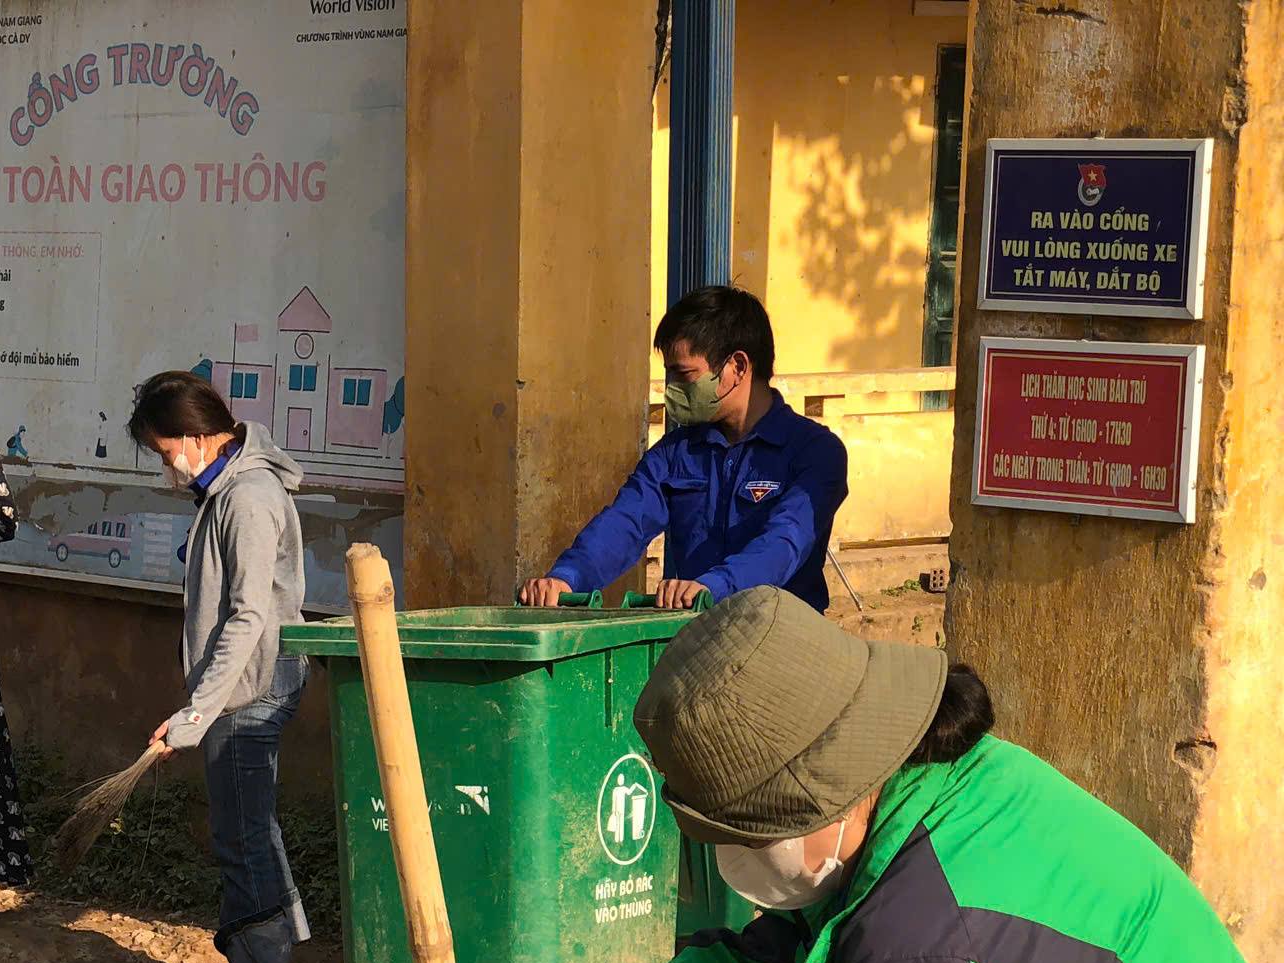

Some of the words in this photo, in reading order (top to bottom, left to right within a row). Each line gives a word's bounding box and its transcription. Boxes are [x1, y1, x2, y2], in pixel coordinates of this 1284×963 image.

[17, 15, 42, 26] GIANG
[376, 28, 394, 39] NAM
[395, 27, 408, 37] GIA
[19, 32, 31, 43] DY
[107, 43, 260, 136] TRƯỜNG
[3, 155, 92, 203] TOÀN
[101, 163, 186, 203] GIAO
[194, 152, 327, 203] THÔNG
[1031, 211, 1054, 229] RA
[1059, 209, 1094, 230] VÀO
[1099, 206, 1149, 232] CỔNG
[1001, 239, 1029, 257] VUI
[1034, 236, 1081, 259] LÒNG
[1086, 236, 1148, 261] XUỐNG
[1153, 244, 1177, 262] XE
[1014, 262, 1044, 287] TẮT
[1049, 267, 1091, 290] MÁY,
[1096, 266, 1131, 291] DẮT
[1136, 270, 1161, 295] BỘ
[8, 351, 22, 366] đội
[38, 352, 55, 366] bảo
[56, 352, 80, 367] hiểm
[1021, 373, 1040, 402] LỊCH
[1043, 370, 1066, 399] THĂM
[1067, 376, 1085, 406] HỌC
[1086, 376, 1108, 402] SINH
[1109, 373, 1128, 404] BÁN
[1071, 418, 1097, 443] 16H00
[1105, 421, 1132, 446] 17H30
[993, 448, 1010, 478] CÁC
[1011, 450, 1035, 480] NGÀY
[1036, 457, 1064, 482] TRONG
[1105, 462, 1132, 488] 16H00
[1140, 465, 1167, 491] 16H30
[595, 877, 617, 900] HÃY
[619, 874, 634, 896] BỎ
[635, 871, 653, 893] RÁC
[595, 902, 618, 923] VÀO
[619, 897, 652, 920] THÙNG
